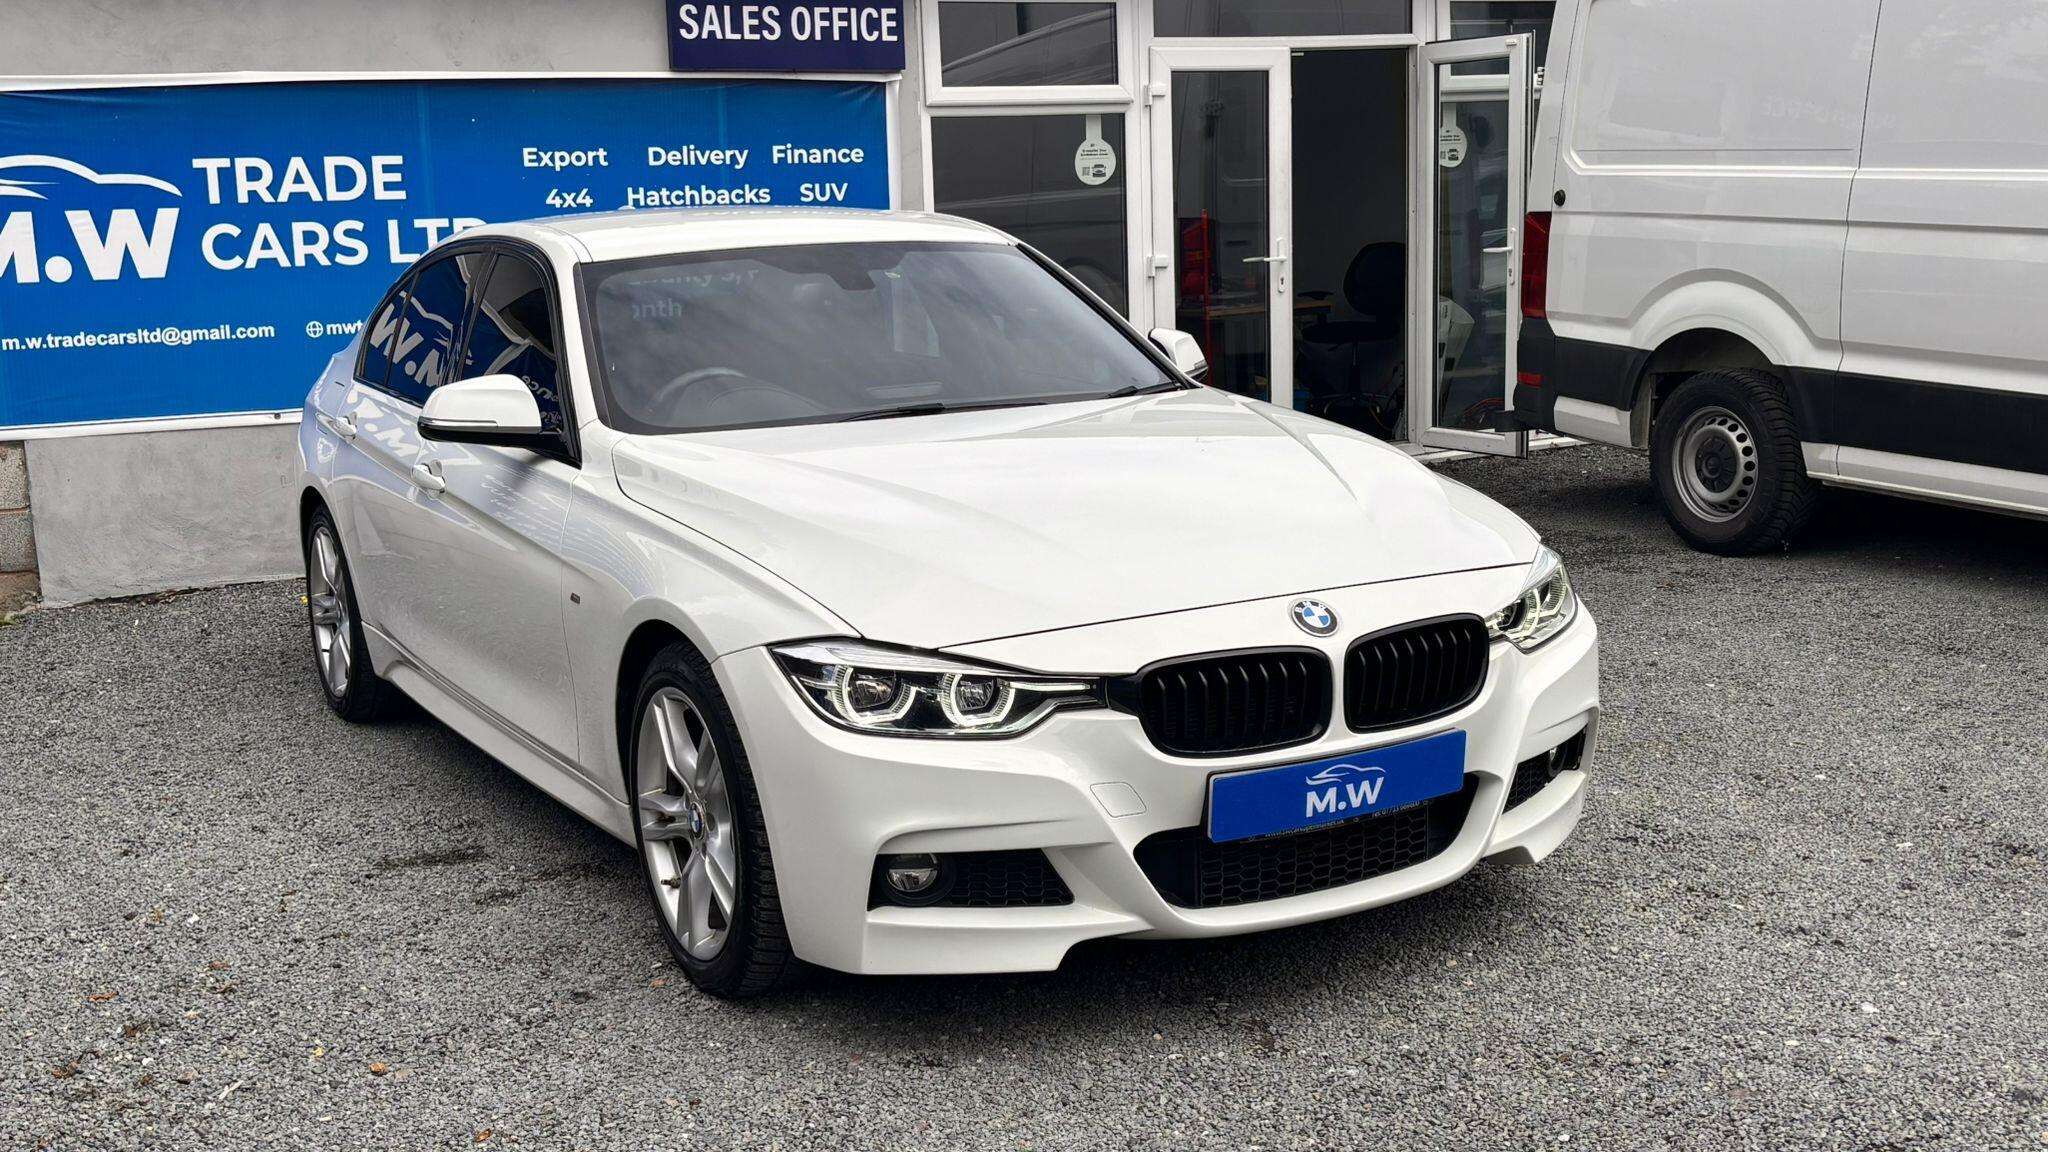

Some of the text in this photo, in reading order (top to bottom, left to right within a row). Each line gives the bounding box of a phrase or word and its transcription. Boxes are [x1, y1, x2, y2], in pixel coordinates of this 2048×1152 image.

[679, 3, 898, 42] SALES OFFICE
[523, 147, 609, 172] Export
[648, 145, 749, 170] Delivery
[772, 143, 865, 164] Finance
[192, 155, 407, 204] TRADE
[799, 182, 849, 202] SUV
[545, 188, 594, 208] 4x4
[627, 184, 771, 207] Hatchbacks
[201, 219, 369, 270] CARS
[2, 324, 275, 350] m.w.tradecarsltd@gmail.com
[1305, 776, 1385, 818] M.W
